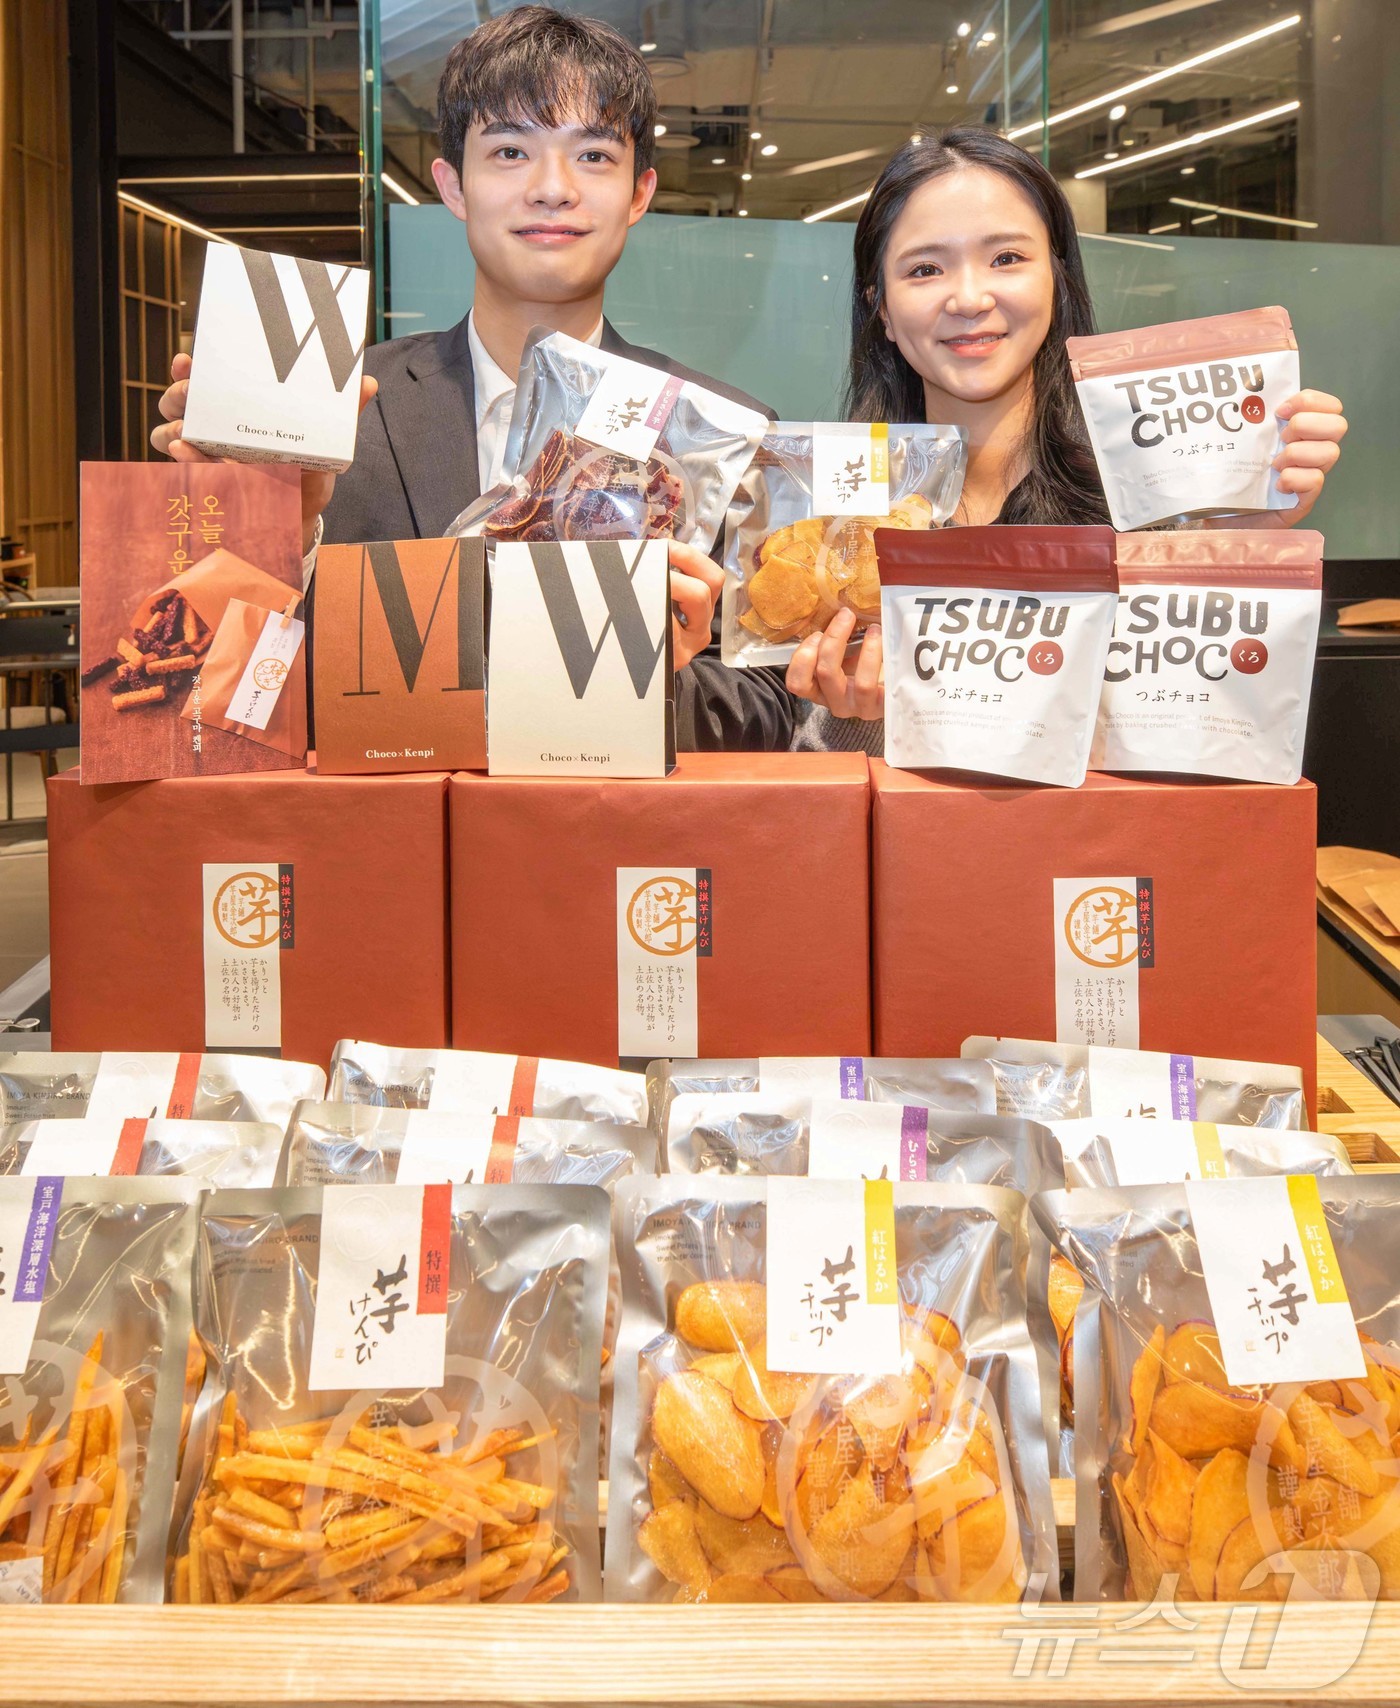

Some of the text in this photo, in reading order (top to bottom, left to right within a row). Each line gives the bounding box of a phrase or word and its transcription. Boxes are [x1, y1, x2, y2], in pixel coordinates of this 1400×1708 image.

[605, 404, 619, 435] チップ
[618, 397, 648, 429] 芋
[1245, 404, 1261, 416] くろ
[1172, 442, 1236, 457] つぶチョコ
[832, 473, 851, 504] チップ
[844, 454, 867, 492] 芋
[166, 494, 194, 575] 갓구운
[1035, 652, 1055, 665] くろ
[1238, 650, 1259, 664] くろ
[192, 675, 202, 705] 갓구운
[937, 688, 1003, 703] つぶチョコ
[1136, 689, 1210, 703] つぶチョコ
[192, 707, 202, 733] 고구마
[259, 959, 269, 995] かりっと
[676, 966, 684, 1003] かりっと
[1105, 977, 1116, 1046] 芋を揚げただけ
[1116, 979, 1125, 1016] かりっと
[847, 1065, 858, 1100] 室戸海
[425, 1249, 442, 1295] 特撰
[872, 1229, 889, 1293] 紅はるか
[1303, 1223, 1335, 1292] 紅はるか
[370, 1253, 410, 1334] 芋
[820, 1245, 860, 1322] 芋
[1262, 1243, 1308, 1326] 芋
[350, 1293, 379, 1365] けんぴ
[800, 1283, 833, 1347] チップ
[1247, 1287, 1289, 1355] チップ
